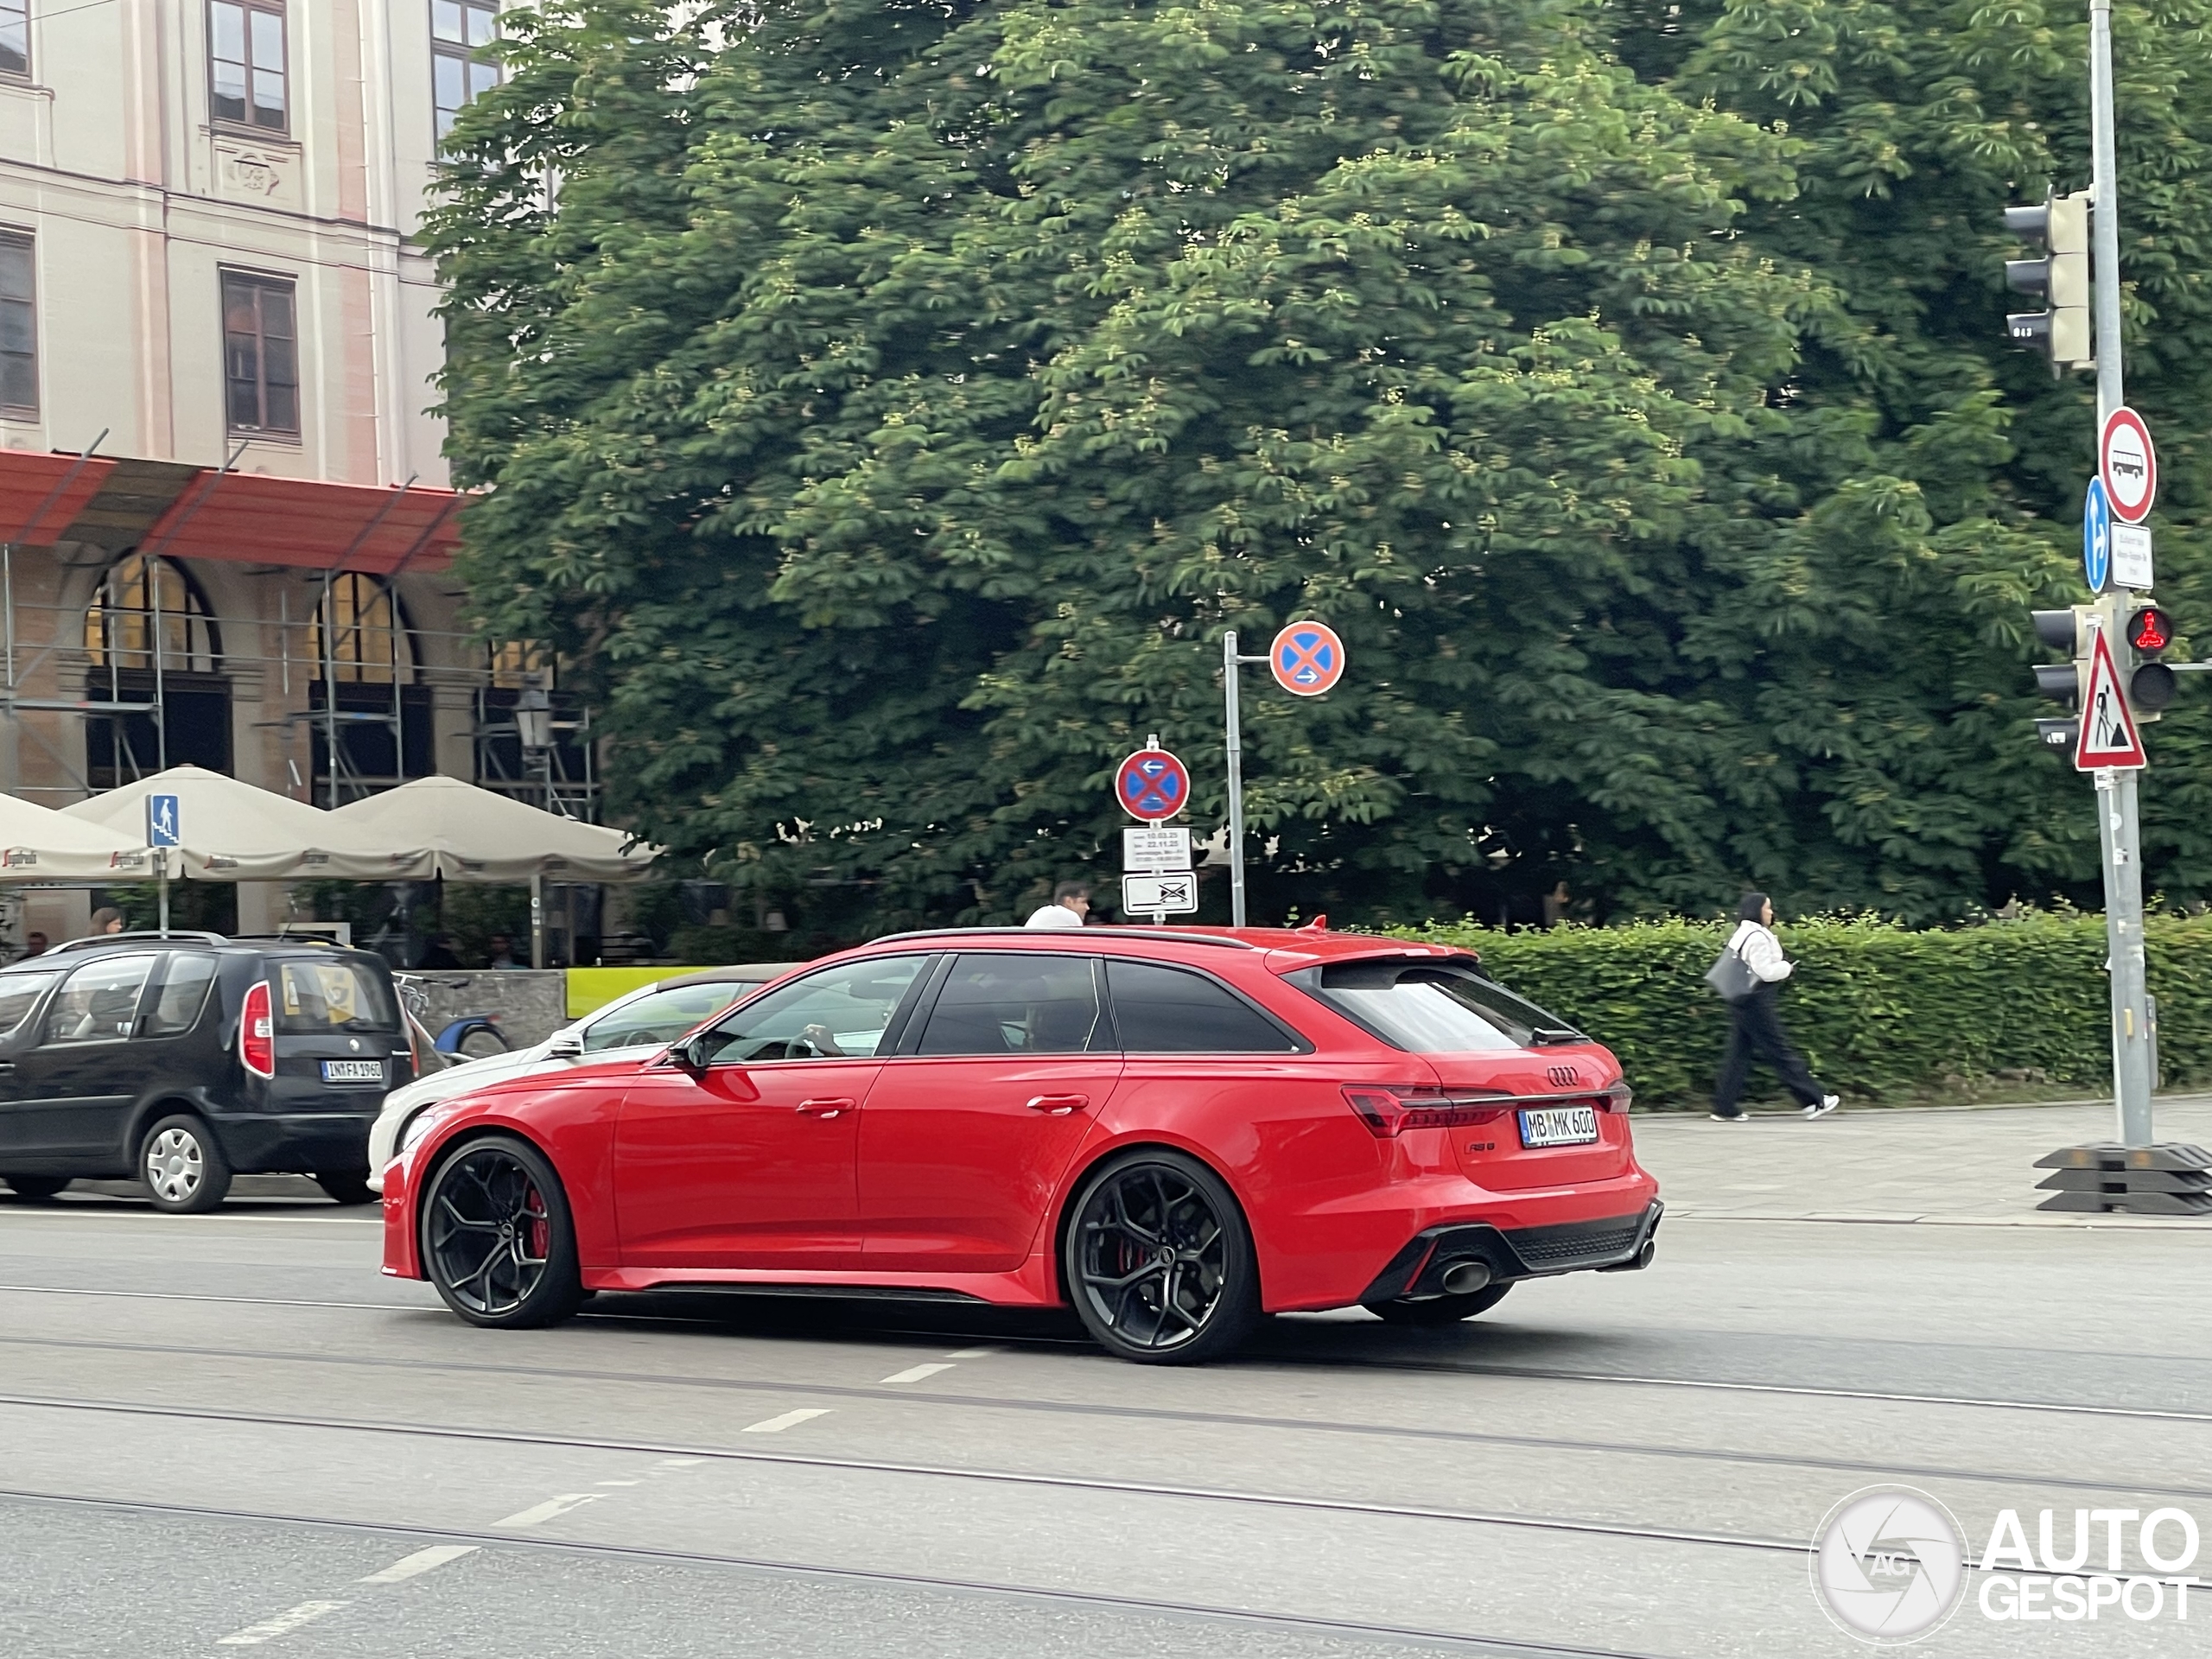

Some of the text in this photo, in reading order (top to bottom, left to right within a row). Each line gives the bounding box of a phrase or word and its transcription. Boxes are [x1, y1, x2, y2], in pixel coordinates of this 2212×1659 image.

[330, 1063, 381, 1077] IN FA 1960
[1528, 1110, 1595, 1138] MB MK 600
